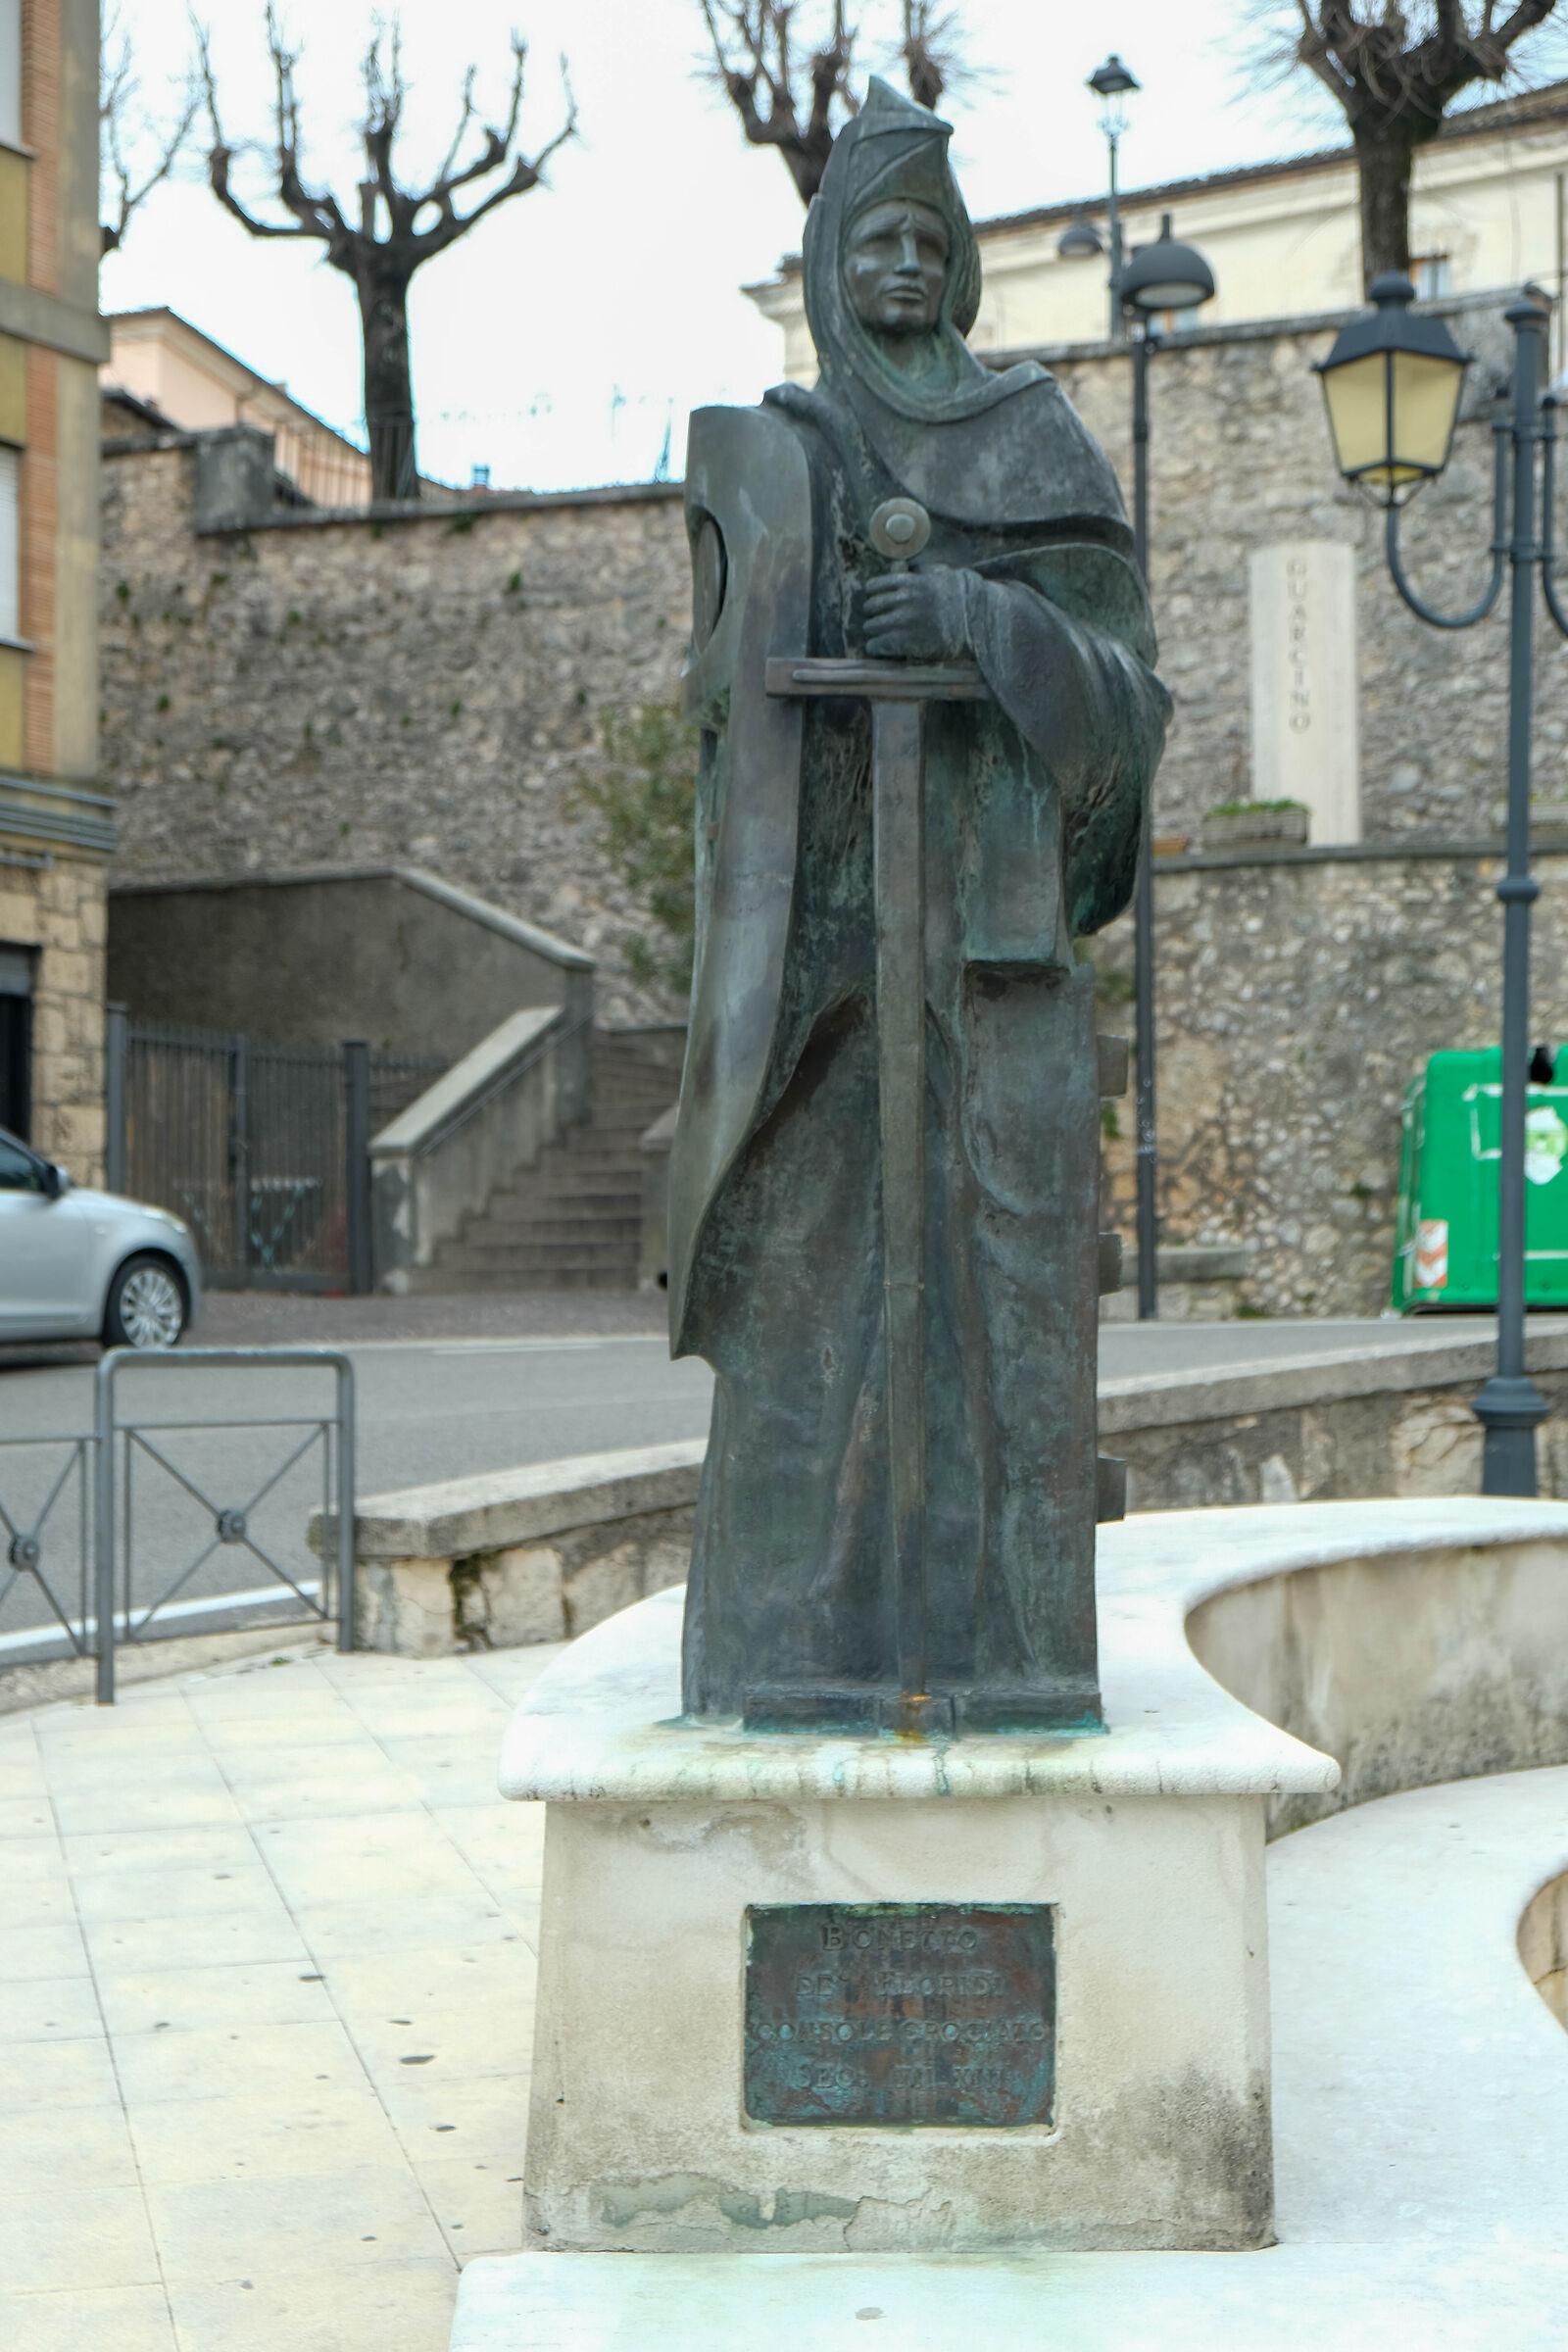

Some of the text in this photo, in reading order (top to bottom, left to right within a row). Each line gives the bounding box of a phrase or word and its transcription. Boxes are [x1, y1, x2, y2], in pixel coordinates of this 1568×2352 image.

[820, 1922, 979, 1951] BONETTO
[875, 1970, 1008, 1997] FLORIDI
[756, 2020, 1051, 2042] CONSOLE CROCIATO
[796, 2064, 870, 2089] SEC.
